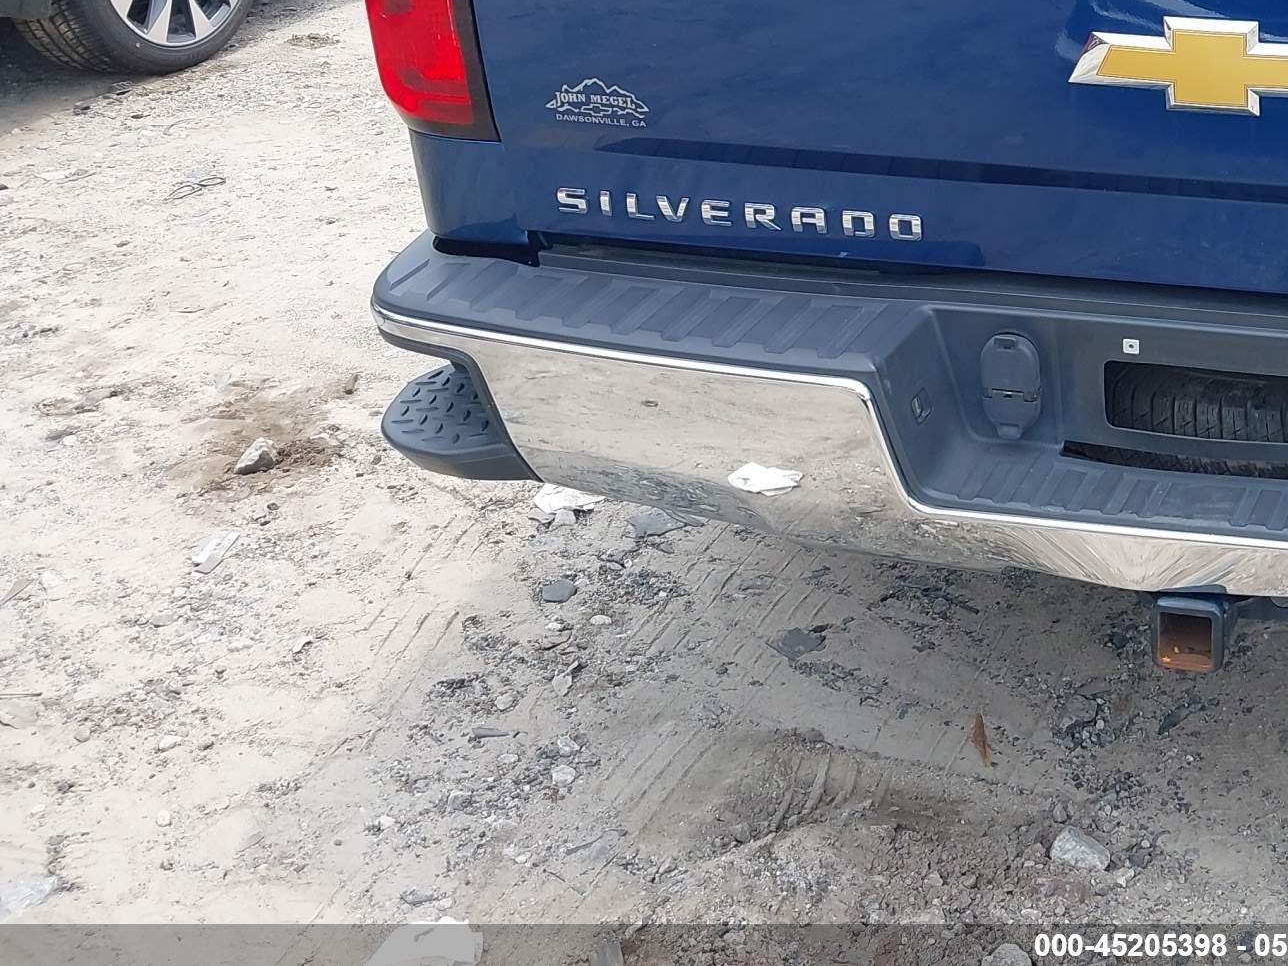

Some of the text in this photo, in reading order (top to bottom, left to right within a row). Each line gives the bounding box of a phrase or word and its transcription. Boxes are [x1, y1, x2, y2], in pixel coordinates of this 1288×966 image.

[555, 92, 635, 109] JOHN MEGEL
[556, 113, 647, 128] DAWSONVILLE, GA
[557, 187, 924, 242] SILVERADO
